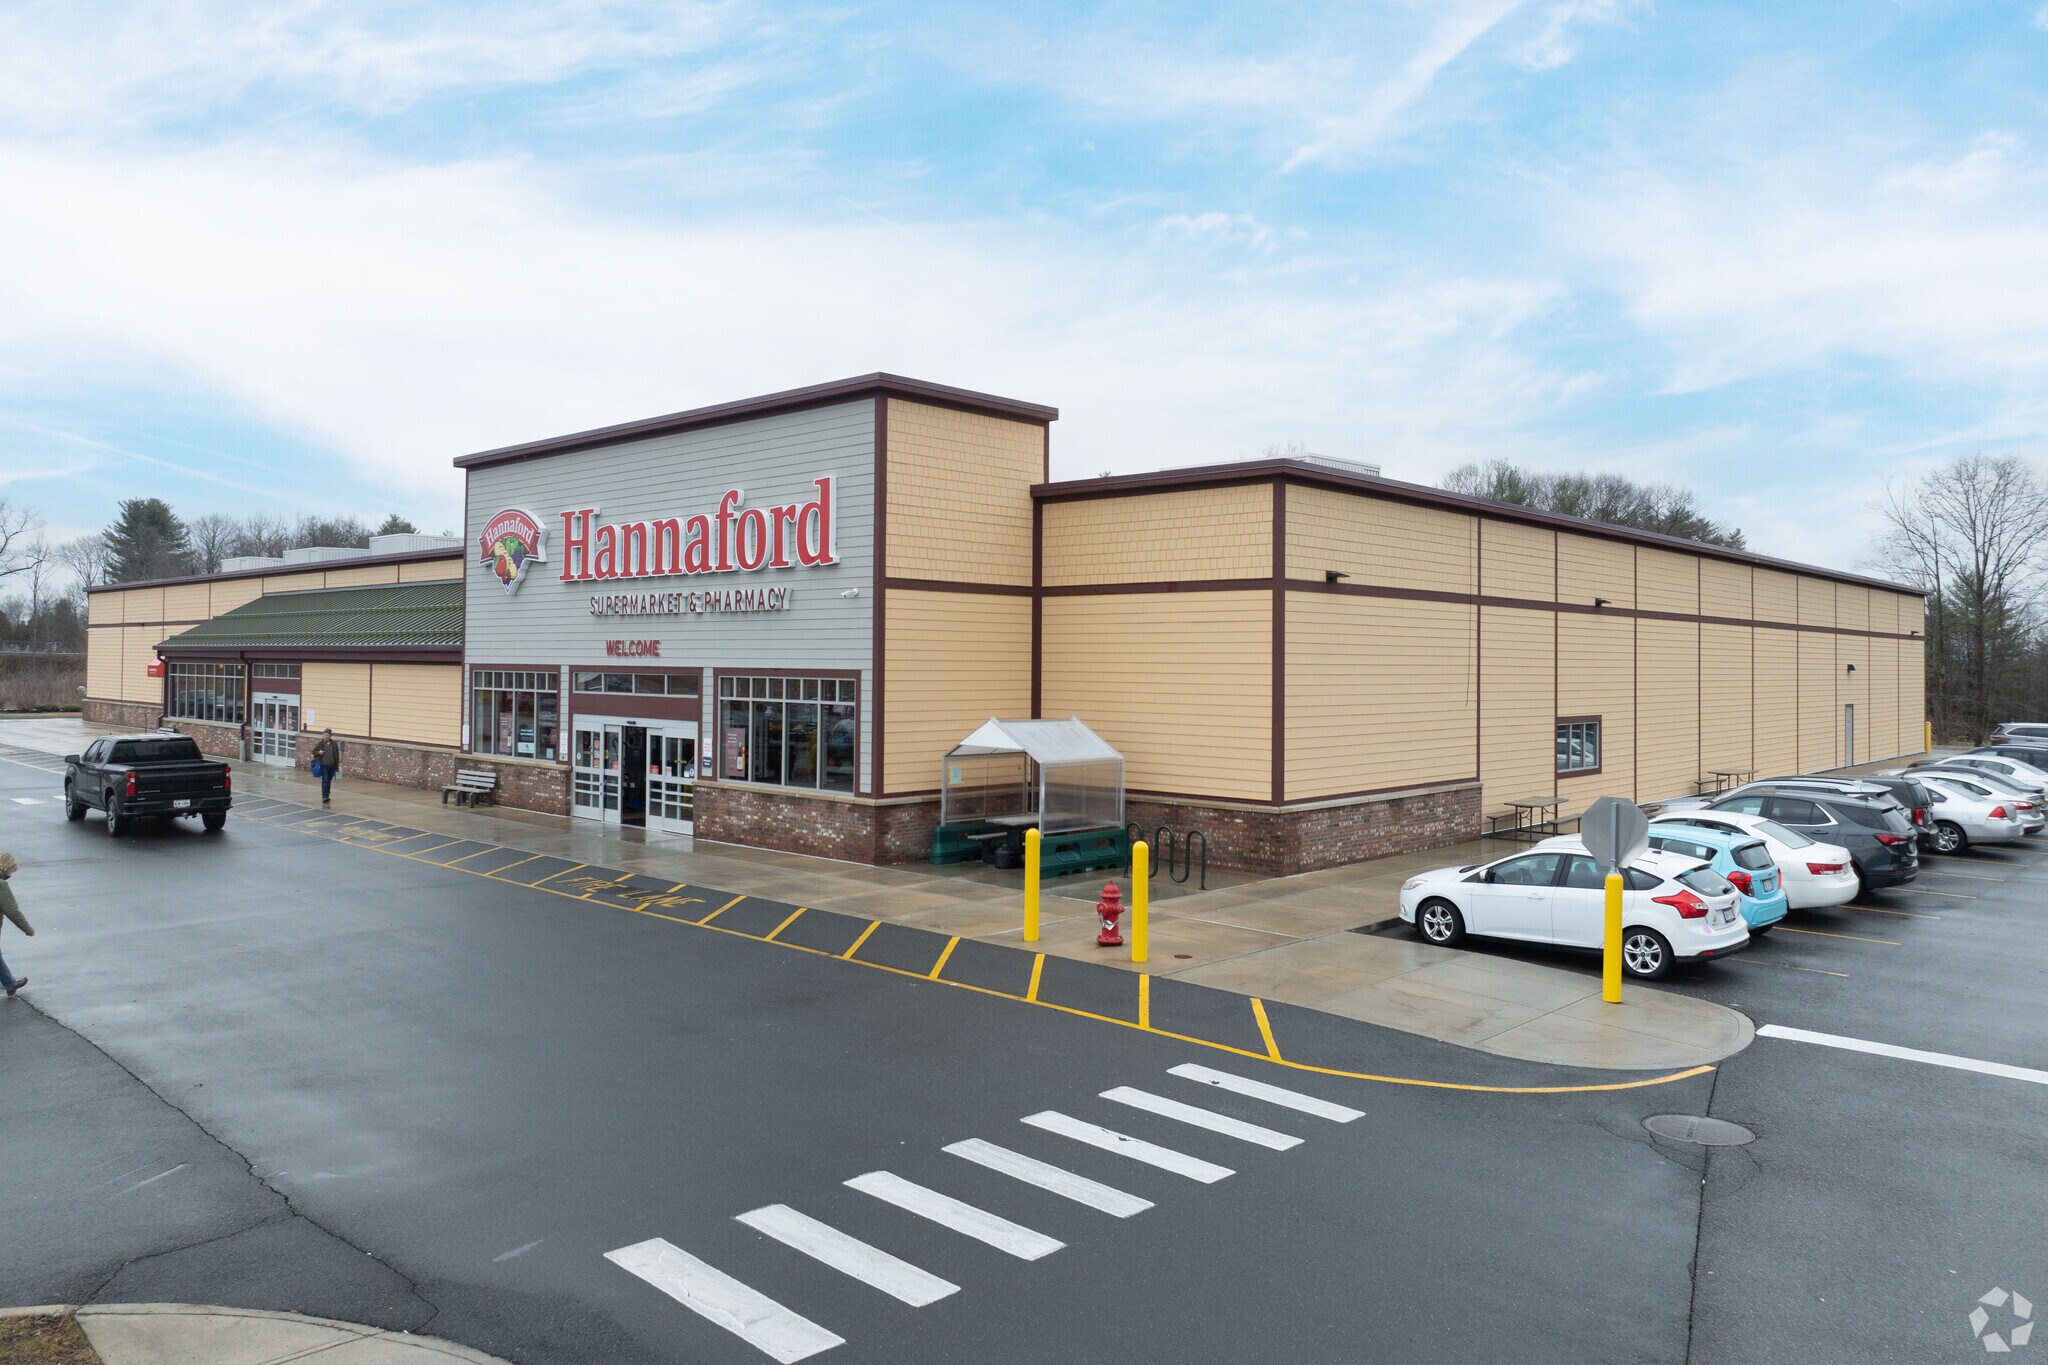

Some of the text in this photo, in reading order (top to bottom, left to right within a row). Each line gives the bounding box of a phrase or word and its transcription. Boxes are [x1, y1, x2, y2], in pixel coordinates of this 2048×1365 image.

[485, 517, 535, 548] Hannaford
[558, 476, 836, 582] Hannaford
[589, 587, 788, 616] SUPERMARKET & PHARMACY
[606, 639, 661, 657] WELCOME
[555, 876, 706, 908] FIRE LANE
